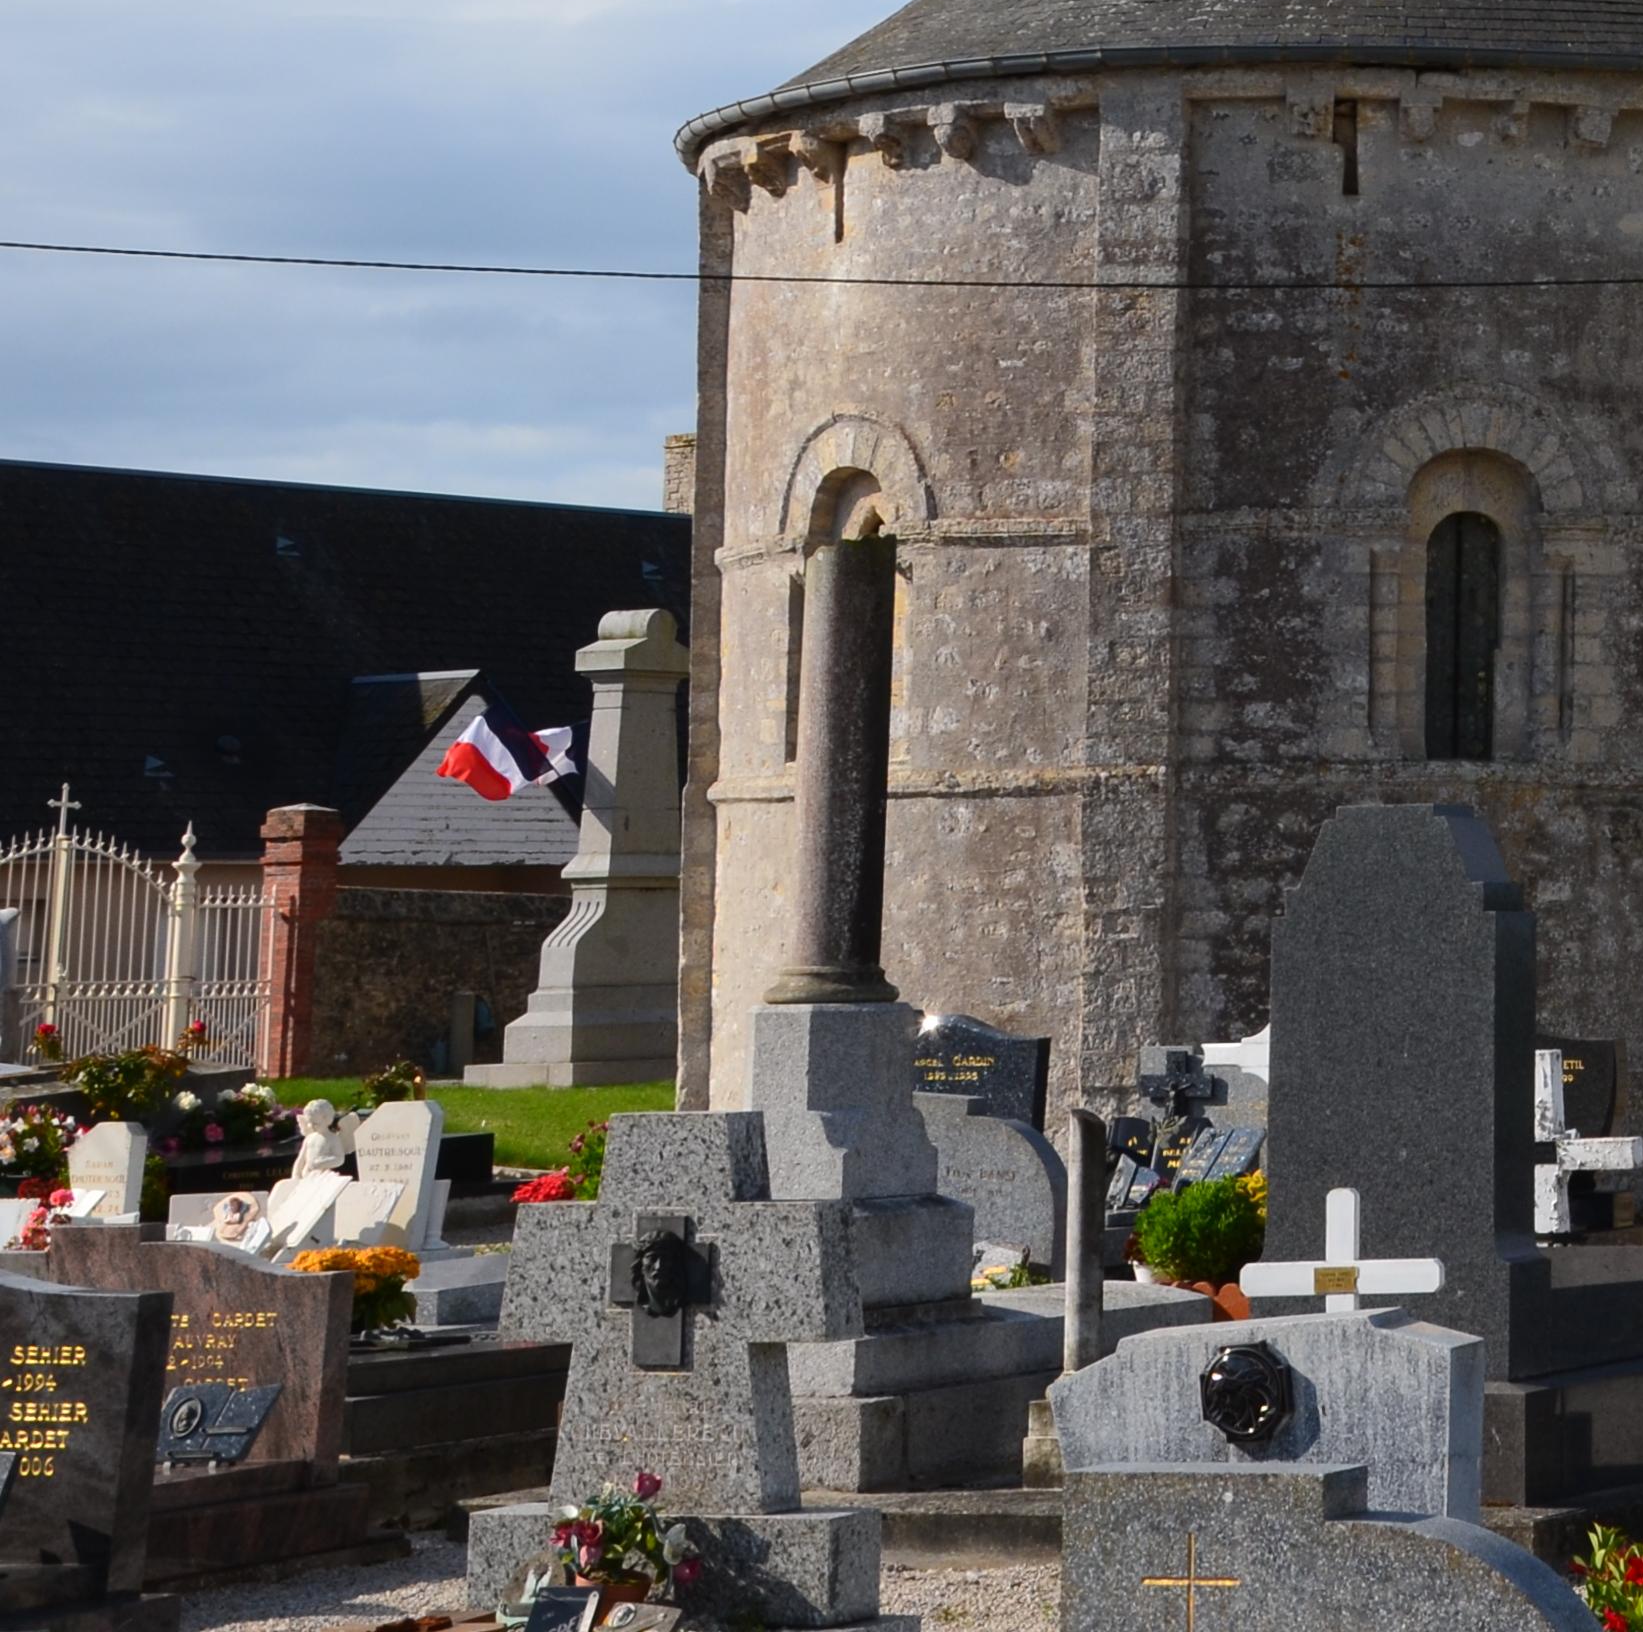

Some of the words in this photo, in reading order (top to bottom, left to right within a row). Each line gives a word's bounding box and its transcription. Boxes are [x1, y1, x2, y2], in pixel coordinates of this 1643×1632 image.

[1563, 1060, 1584, 1069] ETIL
[9, 1344, 87, 1366] SEHIER
[8, 1401, 89, 1424] SEHIER
[0, 1429, 70, 1451] ARDET
[19, 1456, 55, 1476] 006
